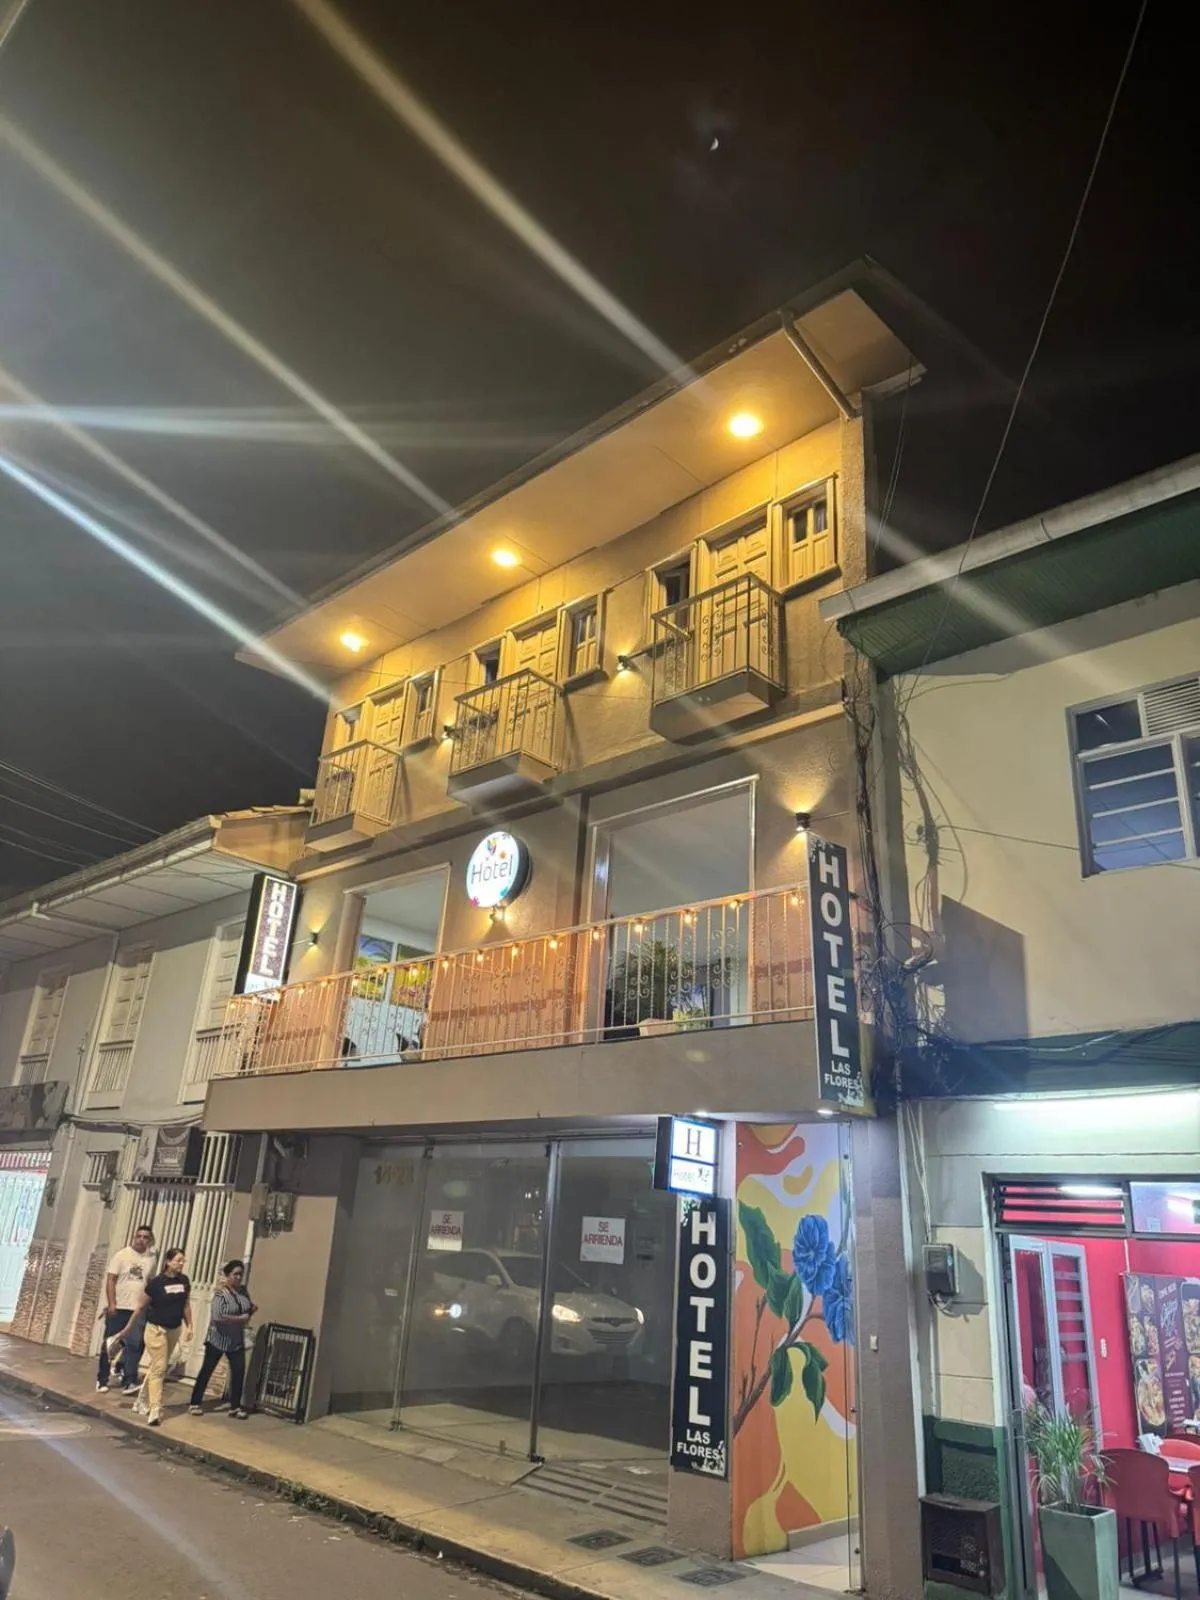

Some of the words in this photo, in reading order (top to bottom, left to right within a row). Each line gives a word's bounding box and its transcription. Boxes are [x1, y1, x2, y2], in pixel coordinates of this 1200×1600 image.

[471, 854, 513, 884] Hotel
[259, 882, 288, 976] HOTEL
[818, 851, 850, 1058] HOTEL
[831, 1060, 851, 1076] LAS
[824, 1073, 860, 1090] FLORES
[684, 1128, 703, 1158] H
[598, 1221, 609, 1233] SE
[584, 1233, 623, 1247] ARRIENDA
[688, 1211, 717, 1427] HOTEL
[686, 1428, 711, 1445] LAS
[676, 1442, 720, 1460] FLORES
